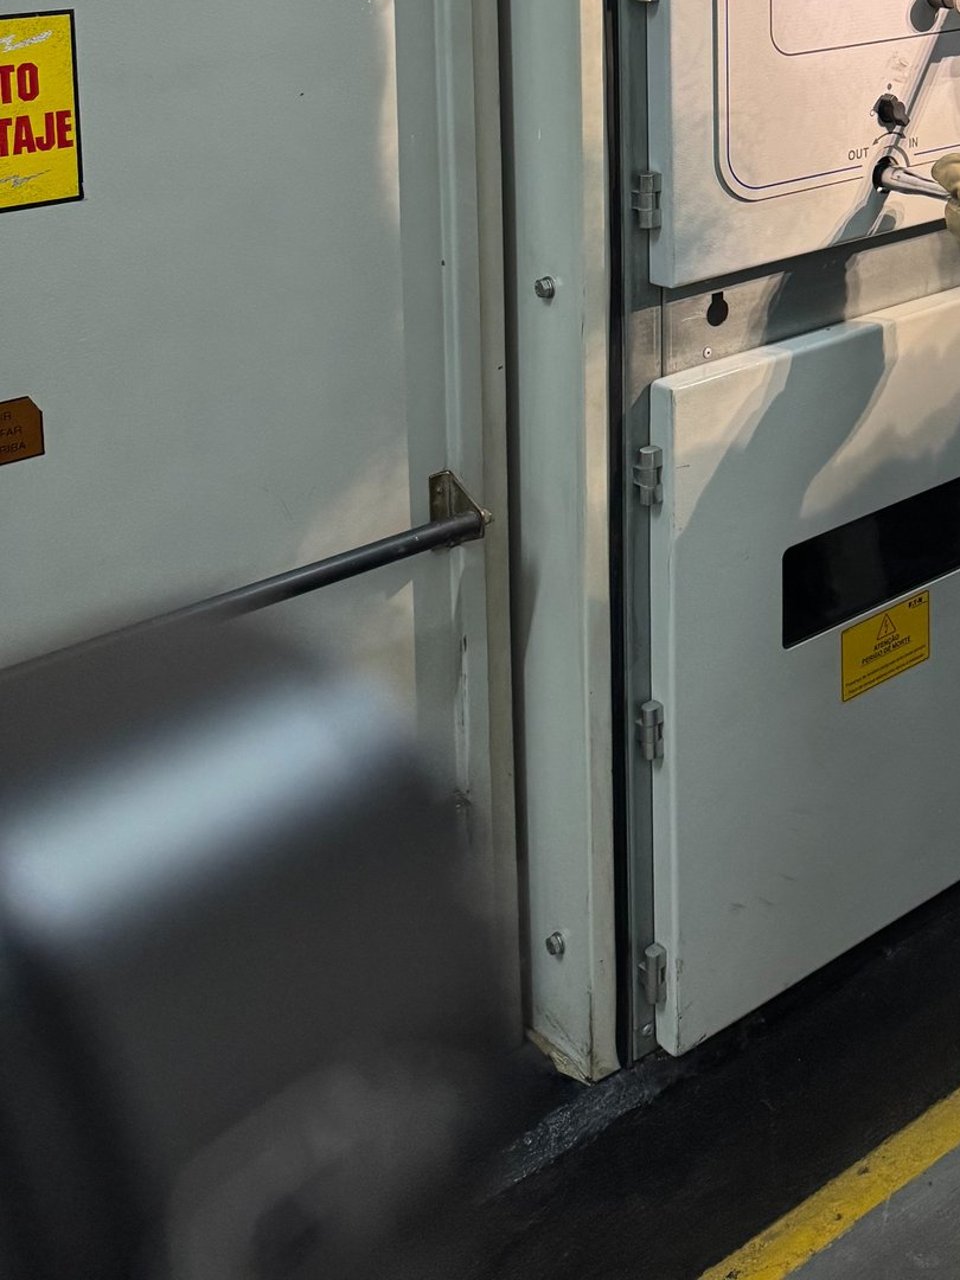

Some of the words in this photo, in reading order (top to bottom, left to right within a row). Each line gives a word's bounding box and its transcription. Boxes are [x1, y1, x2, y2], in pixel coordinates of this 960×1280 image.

[848, 147, 869, 161] OUT
[908, 137, 918, 148] IN
[883, 644, 892, 655] DE
[892, 635, 911, 650] MORTE
